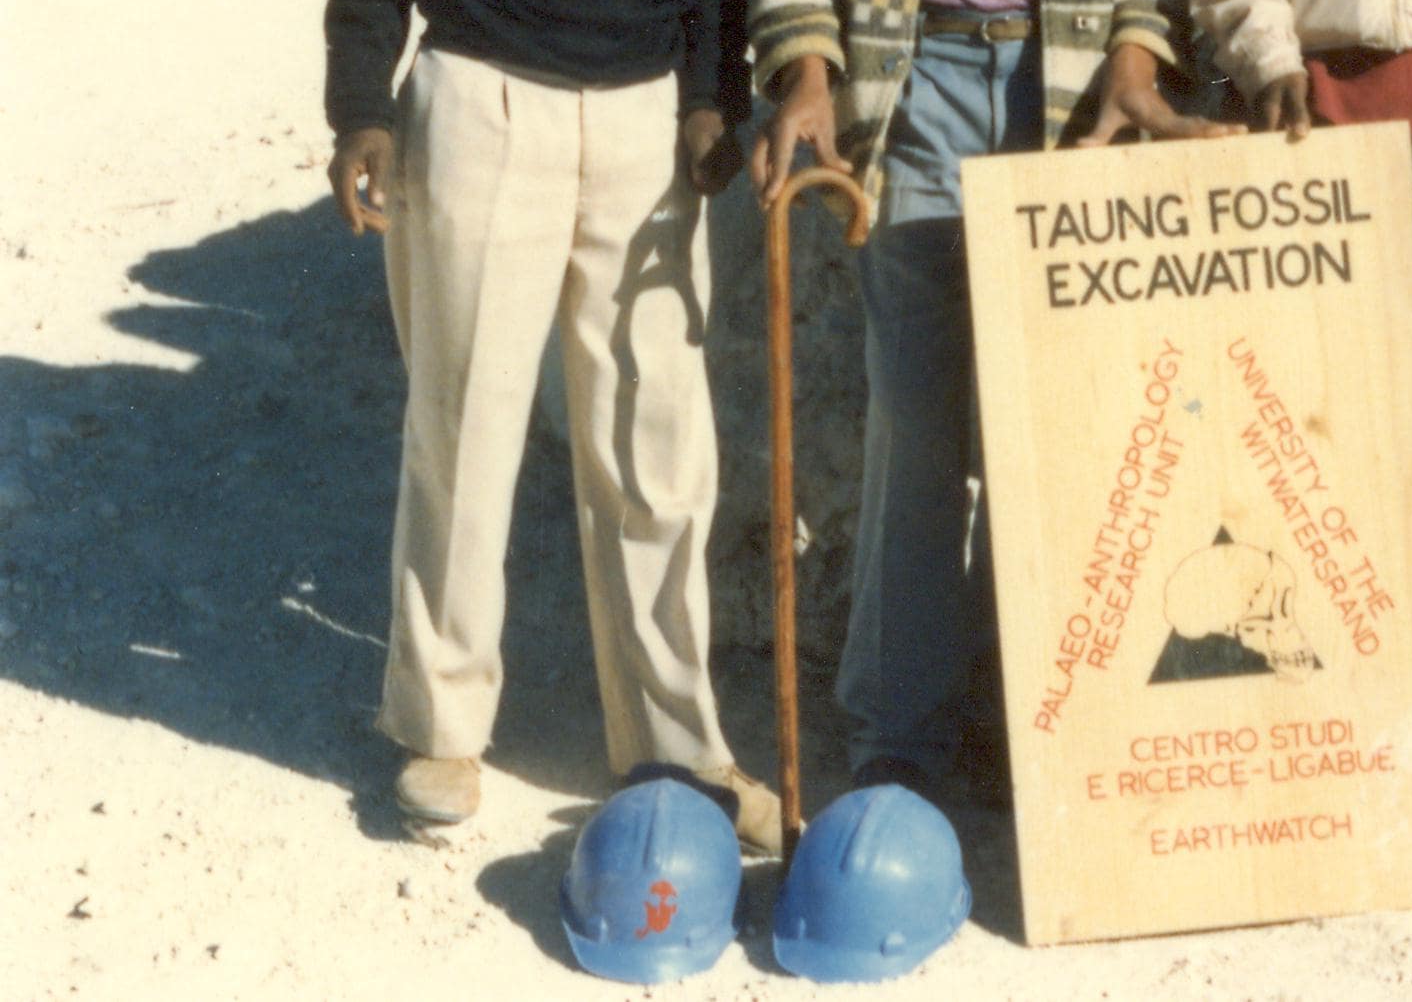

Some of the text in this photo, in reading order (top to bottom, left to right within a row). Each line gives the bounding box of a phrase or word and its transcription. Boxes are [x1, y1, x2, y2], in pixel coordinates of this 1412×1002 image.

[1016, 178, 1371, 250] TAUNG FOSSIL
[1045, 238, 1352, 308] EXCAVATION
[1226, 335, 1396, 621] UNIVERSITY OF THE
[1086, 429, 1185, 671] RESEARCH UNIT
[1240, 420, 1381, 657] WITWATERSRAND
[1129, 719, 1354, 763] CENTRO STUDI
[1086, 773, 1107, 801] E
[1150, 812, 1353, 856] EARTHWATCH
